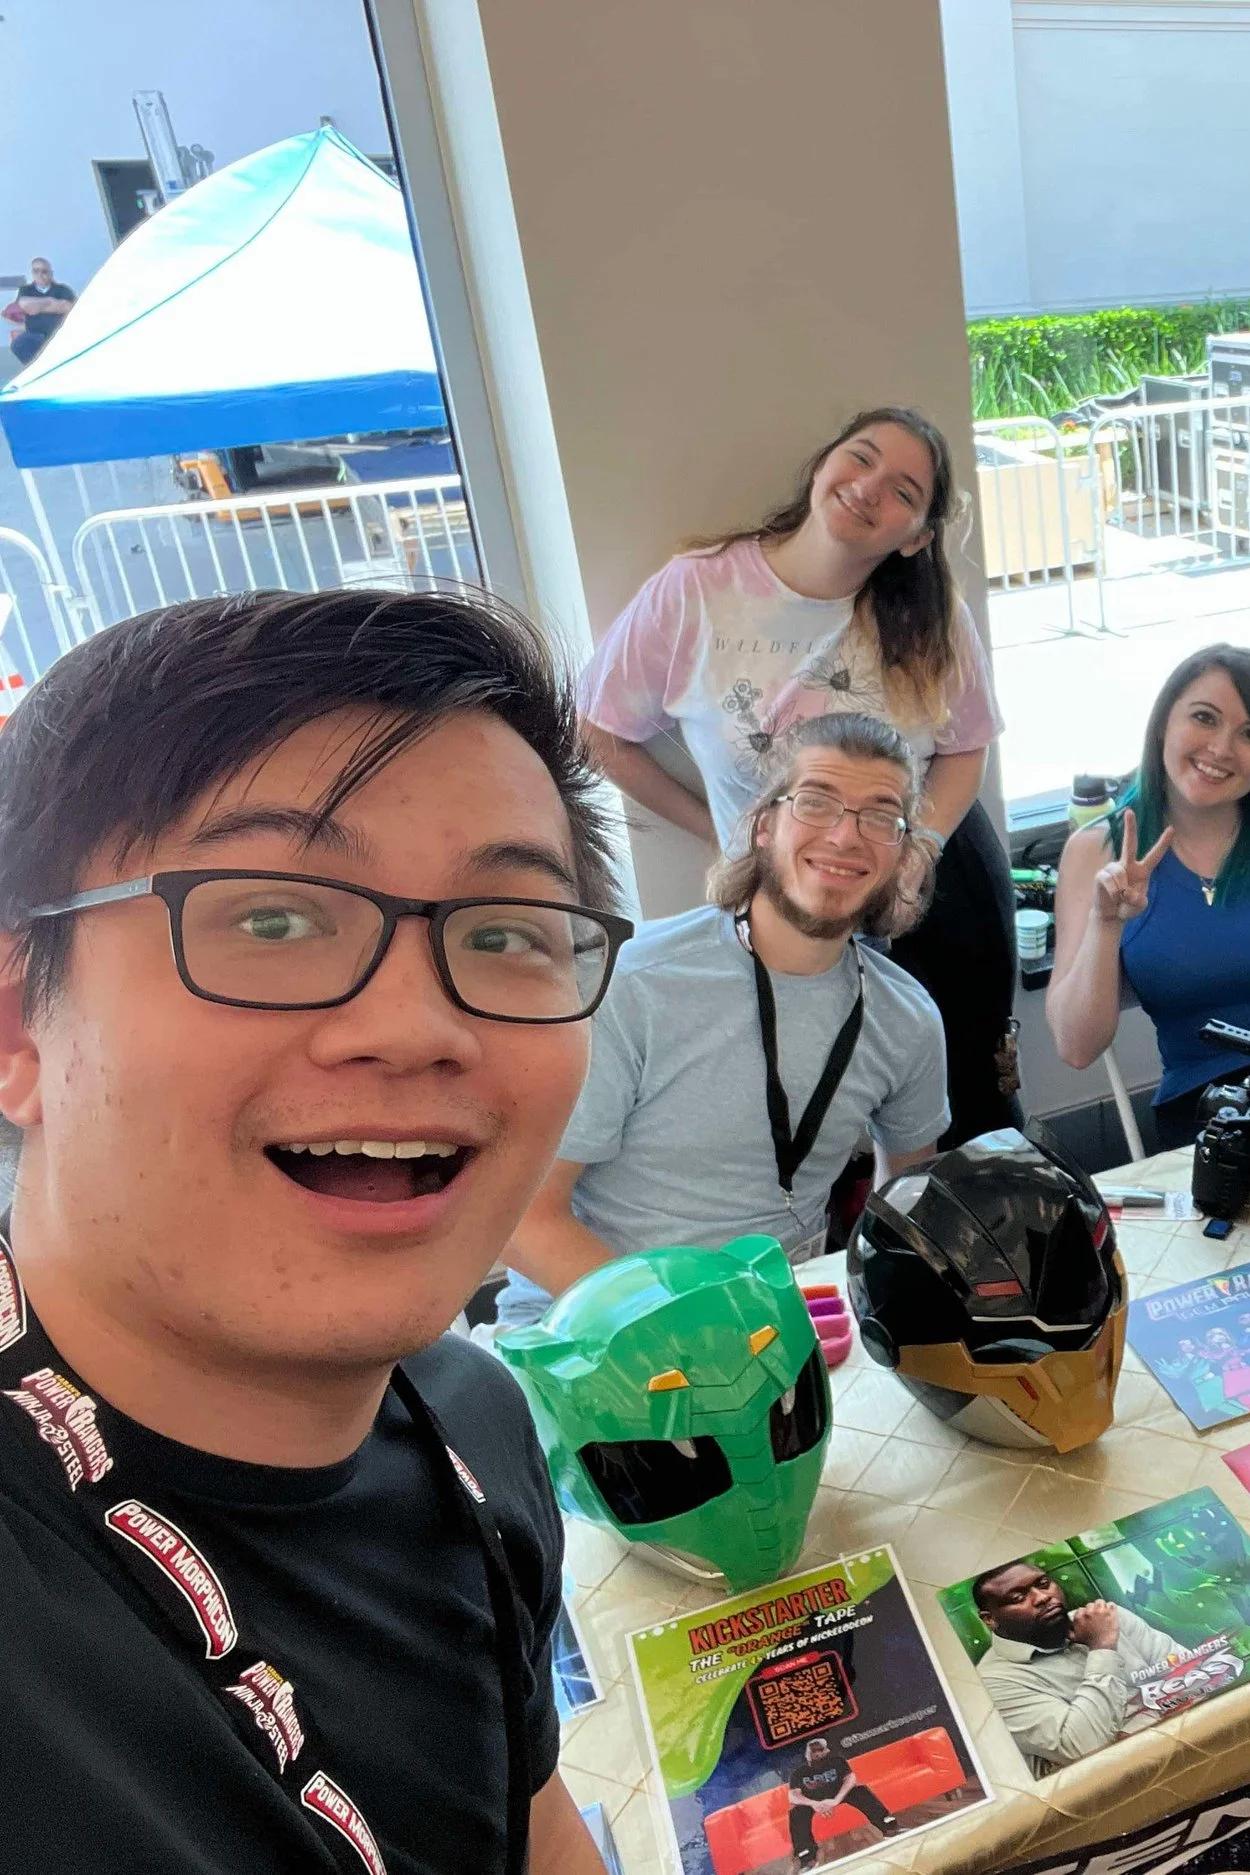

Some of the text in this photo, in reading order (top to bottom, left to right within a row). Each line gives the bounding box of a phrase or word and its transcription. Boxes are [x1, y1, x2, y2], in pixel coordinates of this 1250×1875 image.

[1150, 1286, 1219, 1317] POWER
[3, 1390, 53, 1424] NINJA
[57, 1440, 84, 1492] STEEL
[21, 1367, 76, 1410] POWER
[67, 1405, 114, 1482] RANGERS
[114, 1503, 233, 1652] POWER MORPHICON
[688, 1579, 851, 1655] KICKSTARTER
[690, 1652, 723, 1673] THE
[814, 1605, 857, 1628] TAPE
[796, 1638, 809, 1649] OF
[810, 1614, 874, 1644] NICKELODEON
[1130, 1635, 1229, 1683] POWER RANGERS
[225, 1685, 264, 1714] NINJA
[240, 1661, 281, 1698] POWER
[276, 1693, 305, 1761] RANGERS
[308, 1776, 350, 1823] POWER
